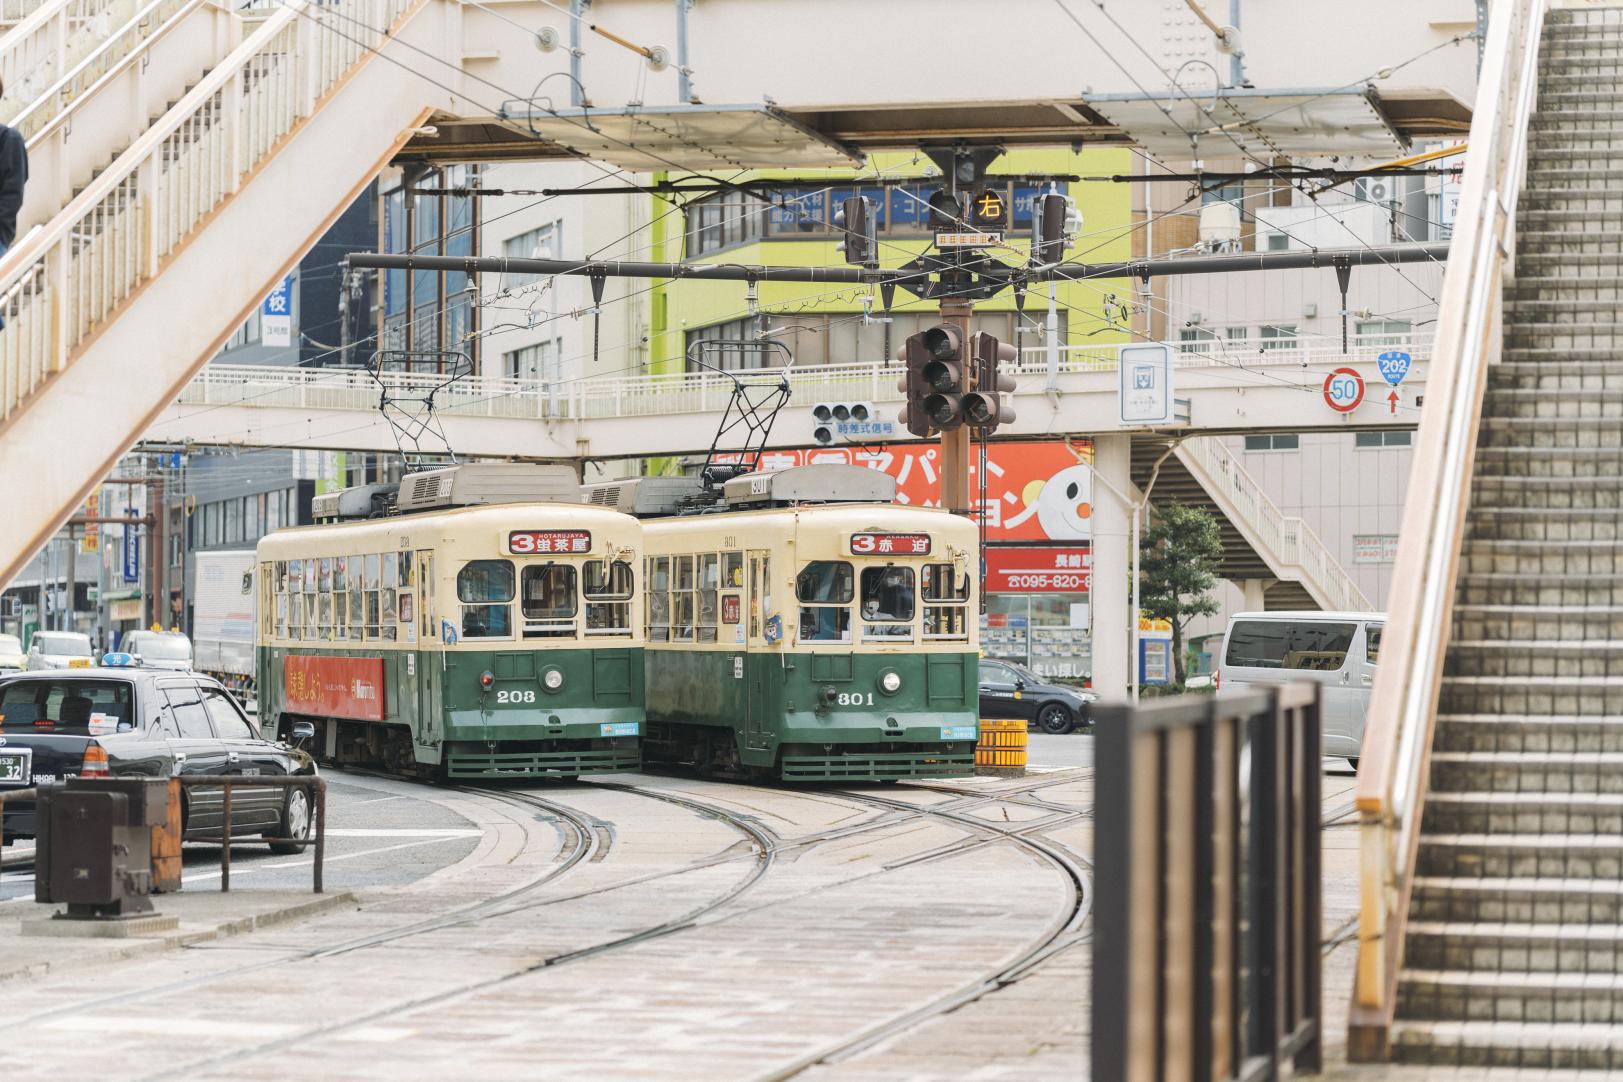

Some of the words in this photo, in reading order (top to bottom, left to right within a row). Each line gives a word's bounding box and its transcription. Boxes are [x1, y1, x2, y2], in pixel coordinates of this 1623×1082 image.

[979, 195, 1001, 217] 右
[1382, 359, 1407, 373] 202
[1332, 380, 1355, 400] 50
[838, 423, 892, 434] 時差式信号
[511, 534, 535, 552] 3
[536, 538, 588, 552] 蛍茶屋
[852, 535, 876, 552] 3
[879, 539, 929, 553] 赤迫
[497, 690, 536, 703] 203
